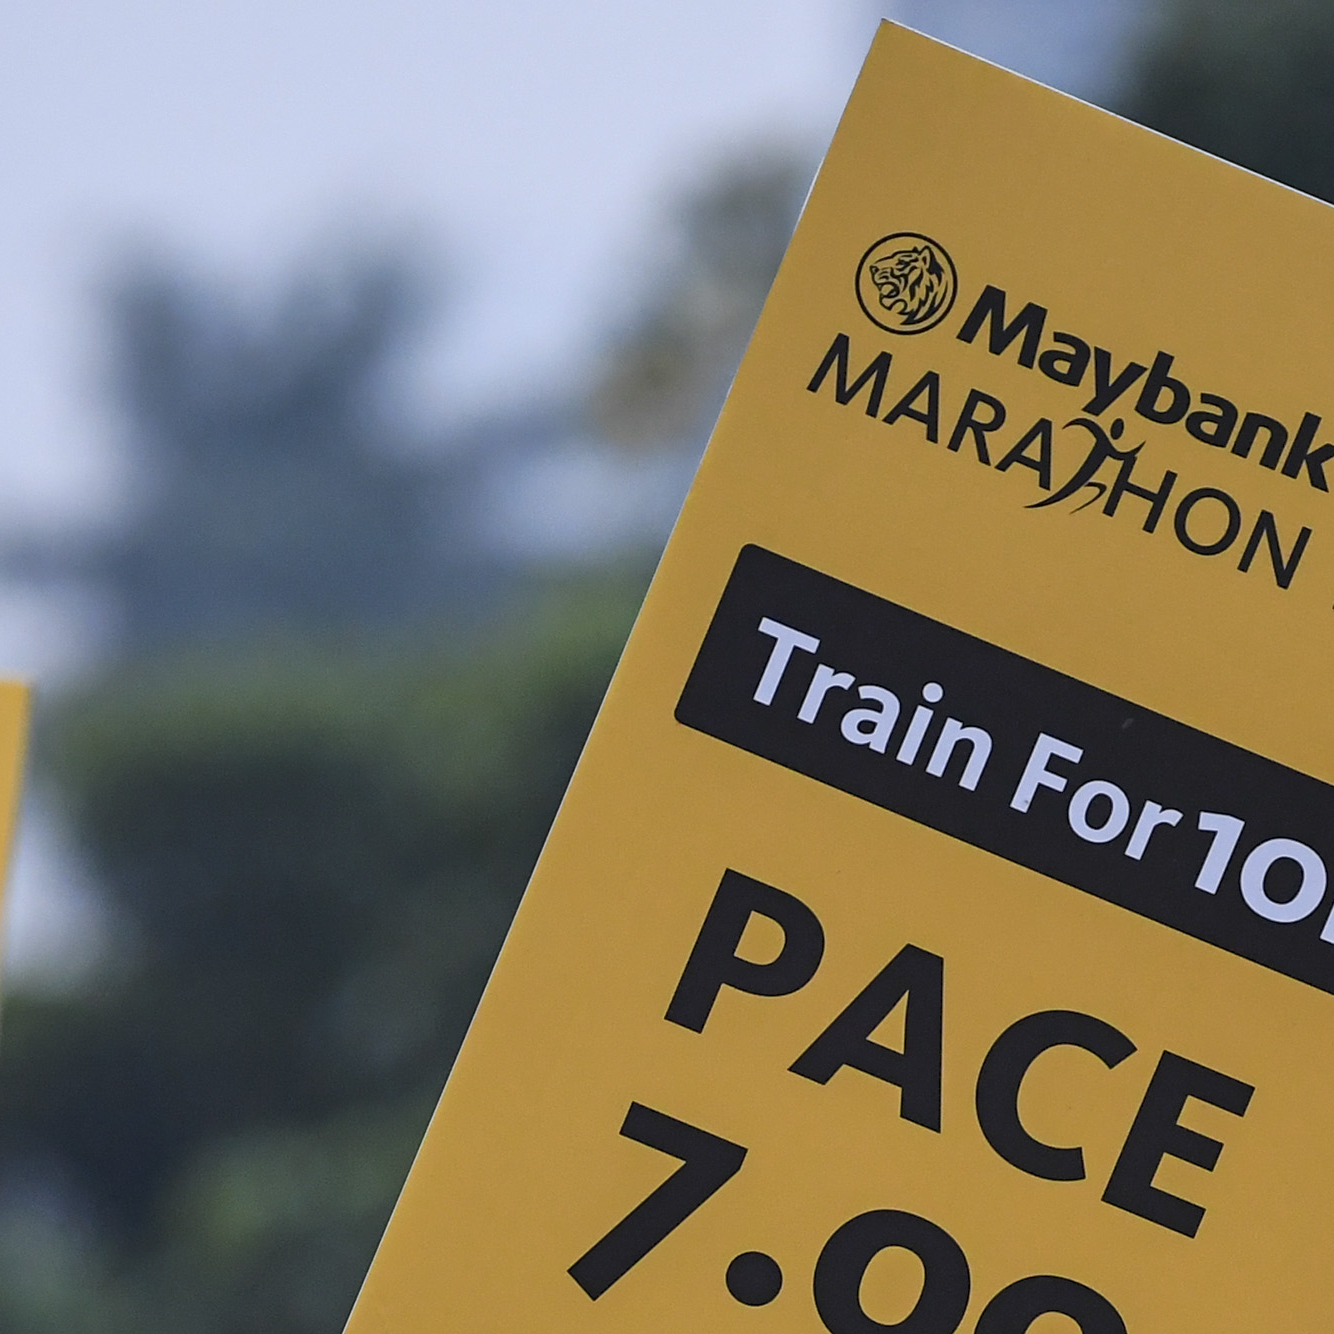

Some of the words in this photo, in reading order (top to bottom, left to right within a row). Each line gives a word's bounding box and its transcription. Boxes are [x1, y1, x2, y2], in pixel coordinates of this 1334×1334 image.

[806, 333, 1313, 590] MARATHON
[748, 616, 993, 792] Train
[1010, 733, 1184, 861] For
[663, 867, 1256, 1239] PACE
